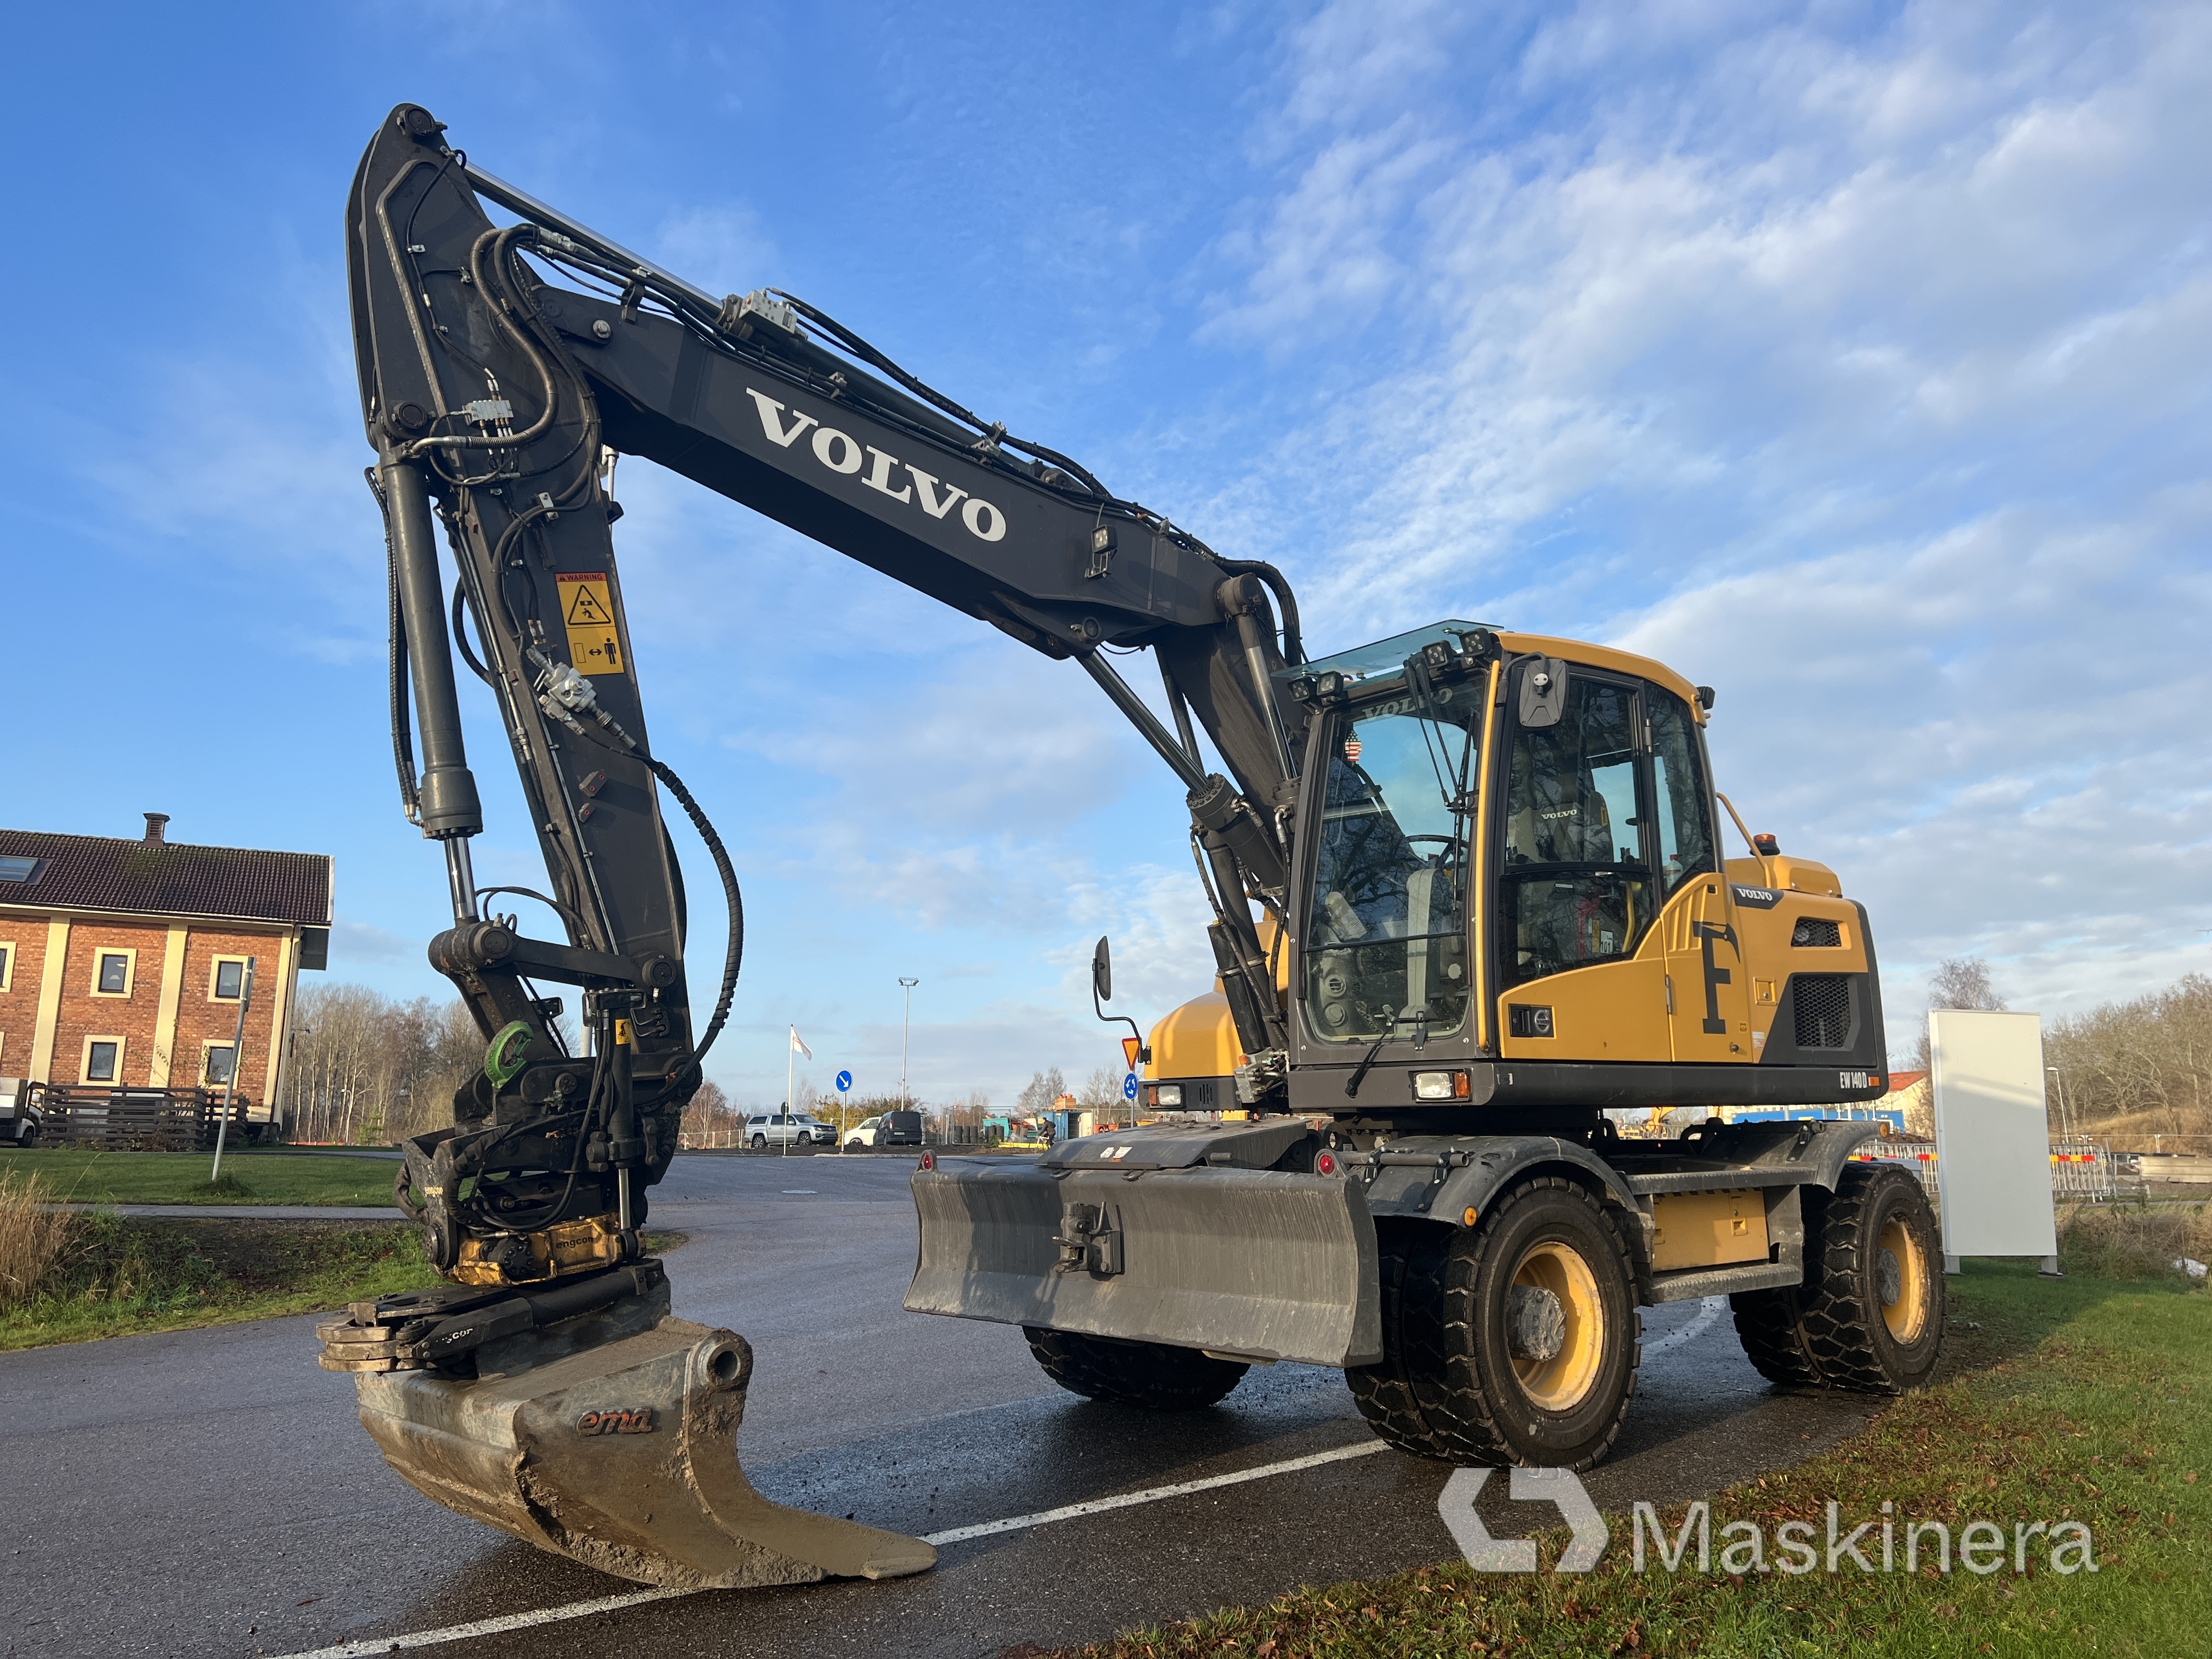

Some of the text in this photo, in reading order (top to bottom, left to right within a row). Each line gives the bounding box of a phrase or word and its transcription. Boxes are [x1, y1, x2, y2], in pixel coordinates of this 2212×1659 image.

[746, 387, 1006, 541] VOLVO
[1541, 809, 1577, 820] VOLVO
[1736, 888, 1773, 901] VOLVO
[1600, 941, 1610, 953] 101
[424, 1187, 444, 1198] engcon
[556, 1237, 594, 1249] engcon
